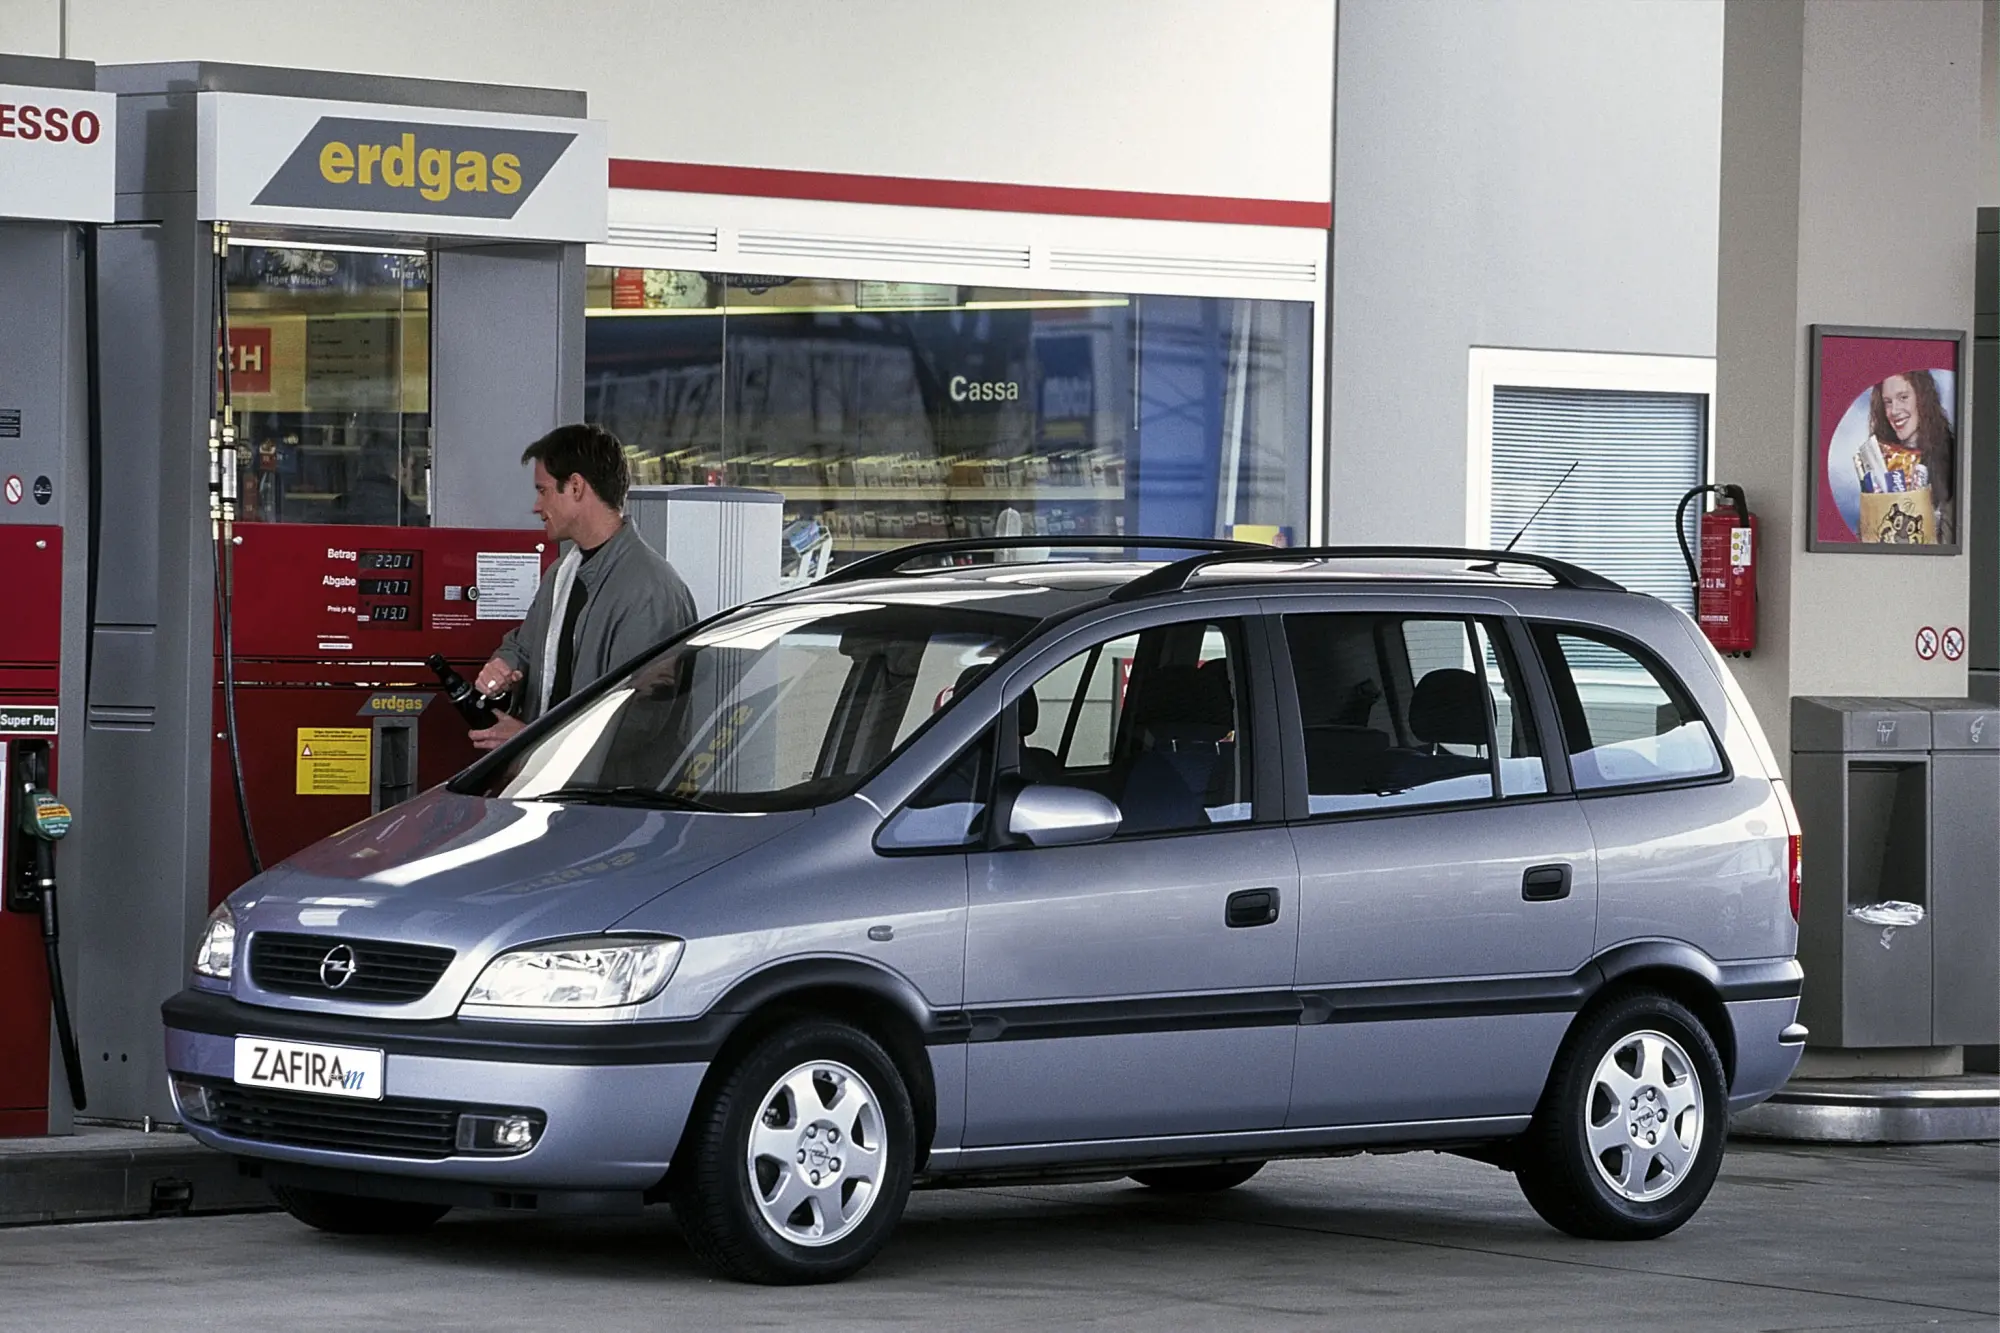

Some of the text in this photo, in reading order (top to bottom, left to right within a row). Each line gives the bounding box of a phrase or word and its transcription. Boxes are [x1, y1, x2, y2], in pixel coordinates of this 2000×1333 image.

[0, 103, 100, 145] ESSO
[319, 133, 522, 202] erdgas
[950, 375, 1019, 402] Cassa
[327, 548, 357, 561] Betrag
[322, 575, 357, 588] Abgabe
[371, 695, 423, 713] erdgas
[0, 714, 56, 728] Super Plus
[251, 1046, 346, 1089] ZAFIRA
